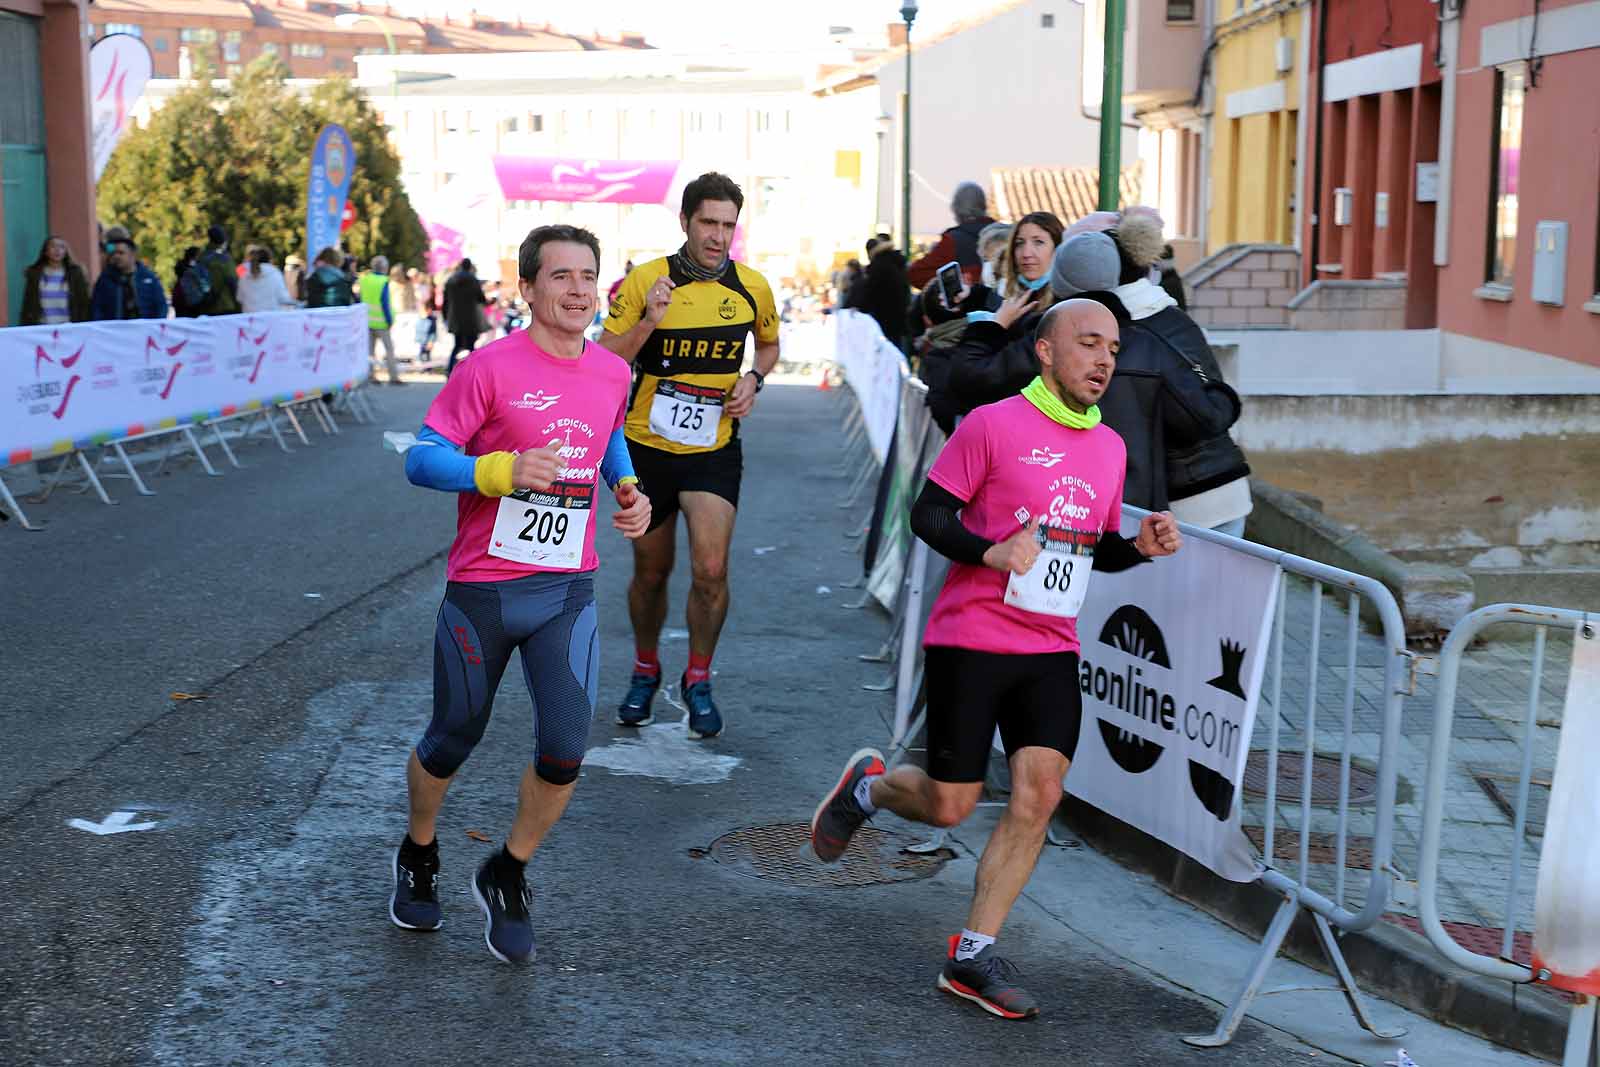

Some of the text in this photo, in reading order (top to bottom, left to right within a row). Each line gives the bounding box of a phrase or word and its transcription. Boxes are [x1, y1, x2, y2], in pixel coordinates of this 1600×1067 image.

[662, 338, 743, 359] URREZ
[671, 402, 704, 430] 125
[517, 508, 569, 546] 209
[1043, 558, 1074, 592] 88
